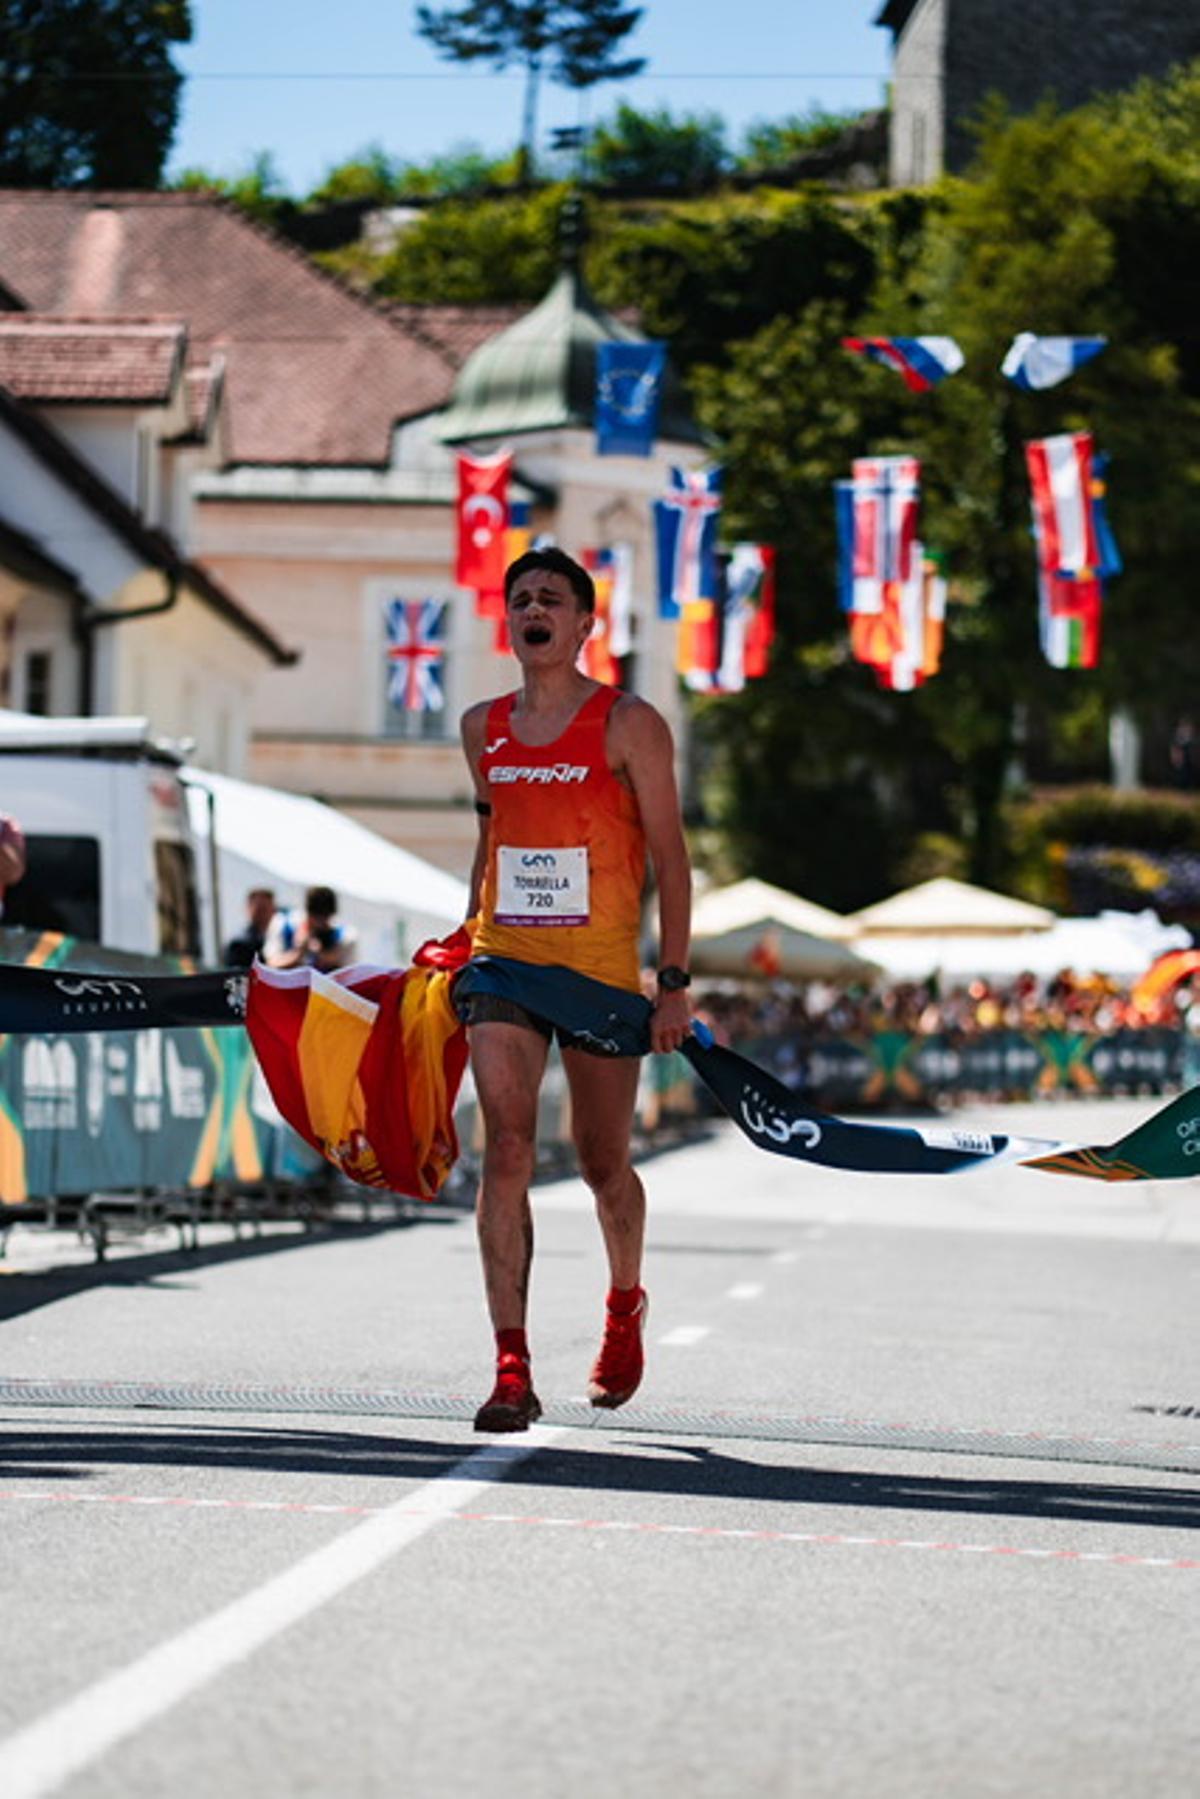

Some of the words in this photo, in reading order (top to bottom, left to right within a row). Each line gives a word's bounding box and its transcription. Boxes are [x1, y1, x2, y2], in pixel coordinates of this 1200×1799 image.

[488, 763, 590, 784] ESPAÑA
[527, 892, 554, 908] 720
[63, 1000, 147, 1015] SKUPINA
